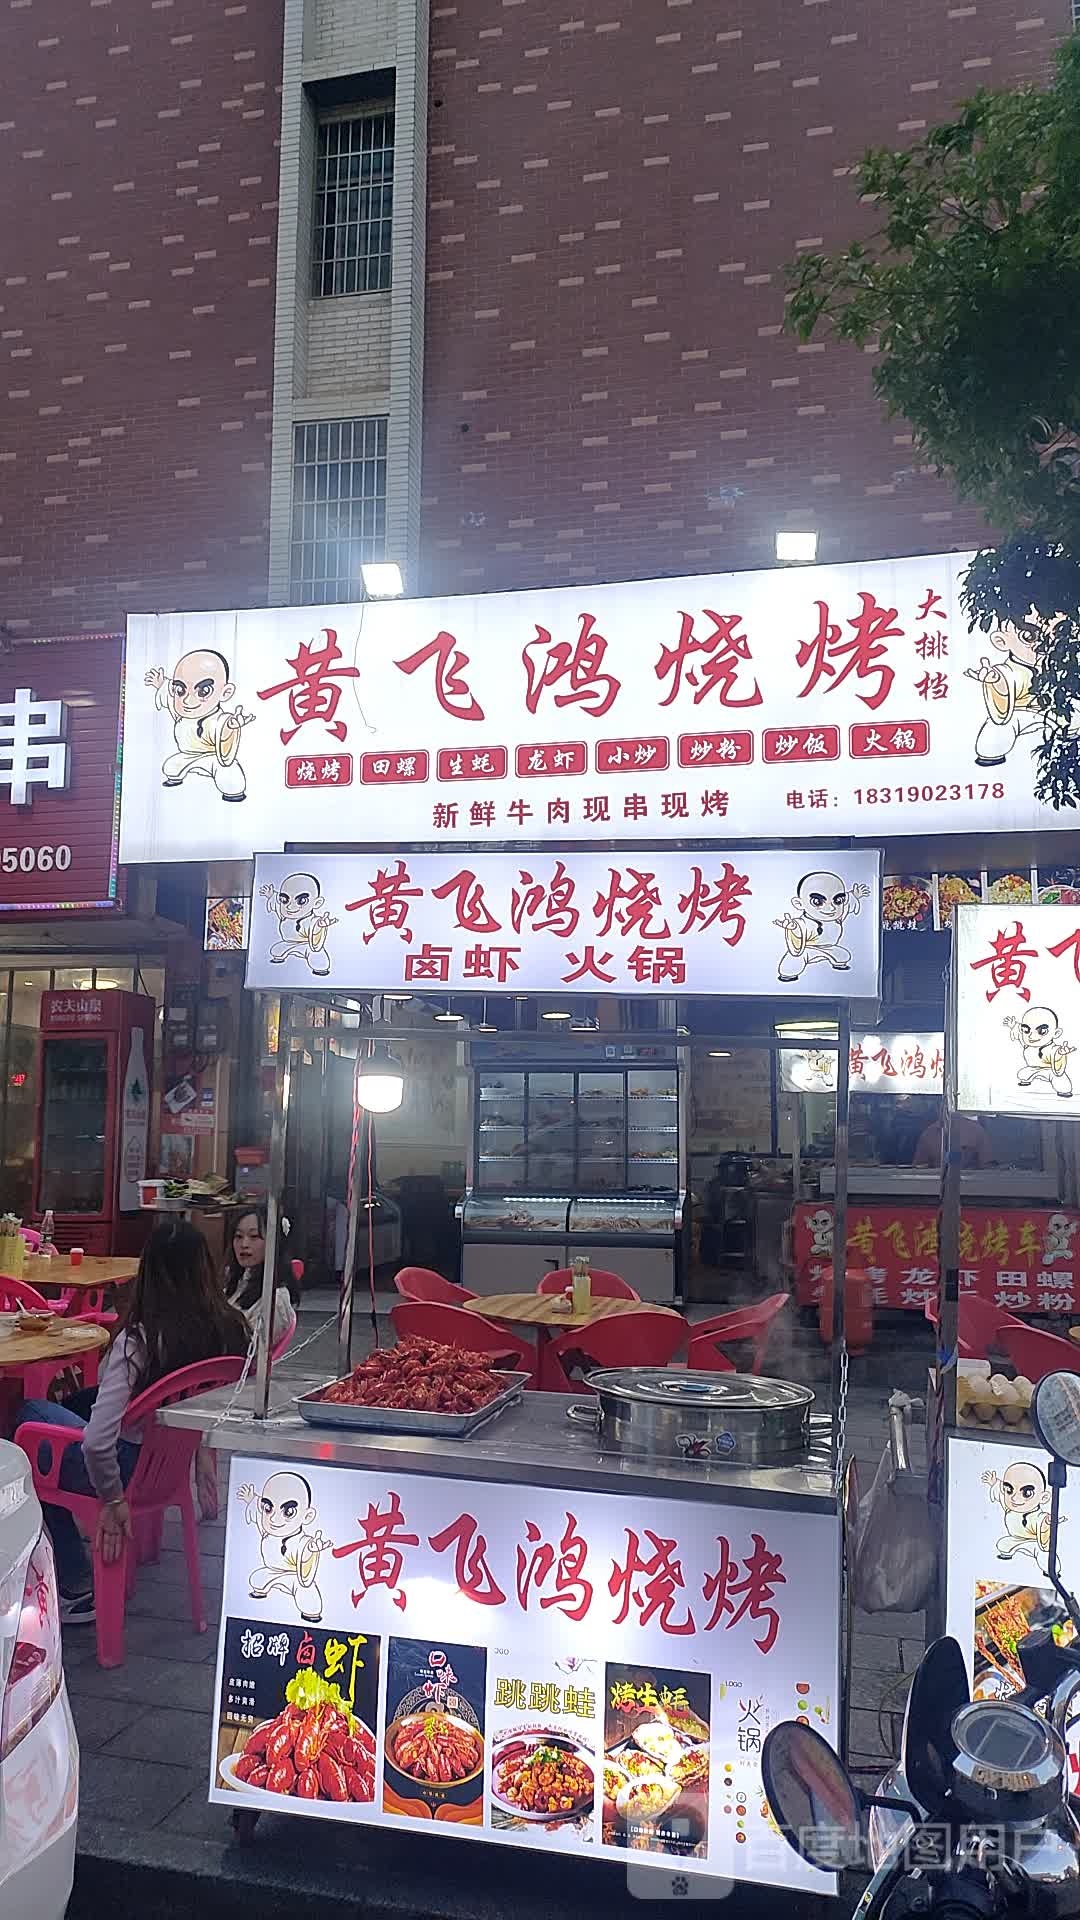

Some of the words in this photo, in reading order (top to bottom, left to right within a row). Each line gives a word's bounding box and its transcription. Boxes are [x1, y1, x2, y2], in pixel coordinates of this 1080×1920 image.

[913, 588, 950, 702] 大排档
[256, 591, 906, 746] 黄飞鸿烧烤
[688, 738, 743, 764] 炒粉
[773, 731, 829, 758] 炒饭
[864, 726, 918, 753] 火锅
[371, 755, 418, 778] 田螺
[447, 751, 497, 776] 生蚝
[526, 746, 577, 772] 龙虾
[606, 742, 658, 768] 小炒
[296, 758, 342, 783] 烧烤
[853, 781, 1005, 806] 18319023178
[431, 788, 731, 830] 新鲜牛肉现串现烤
[344, 859, 753, 947] 黄飞鸿烧烤
[403, 943, 523, 983] 卤虾
[560, 945, 687, 985] 火锅
[332, 1491, 787, 1654] 黄飞鸿烧烤
[494, 1677, 596, 1719] 跳跳蛙
[737, 1696, 763, 1753] 火锅
